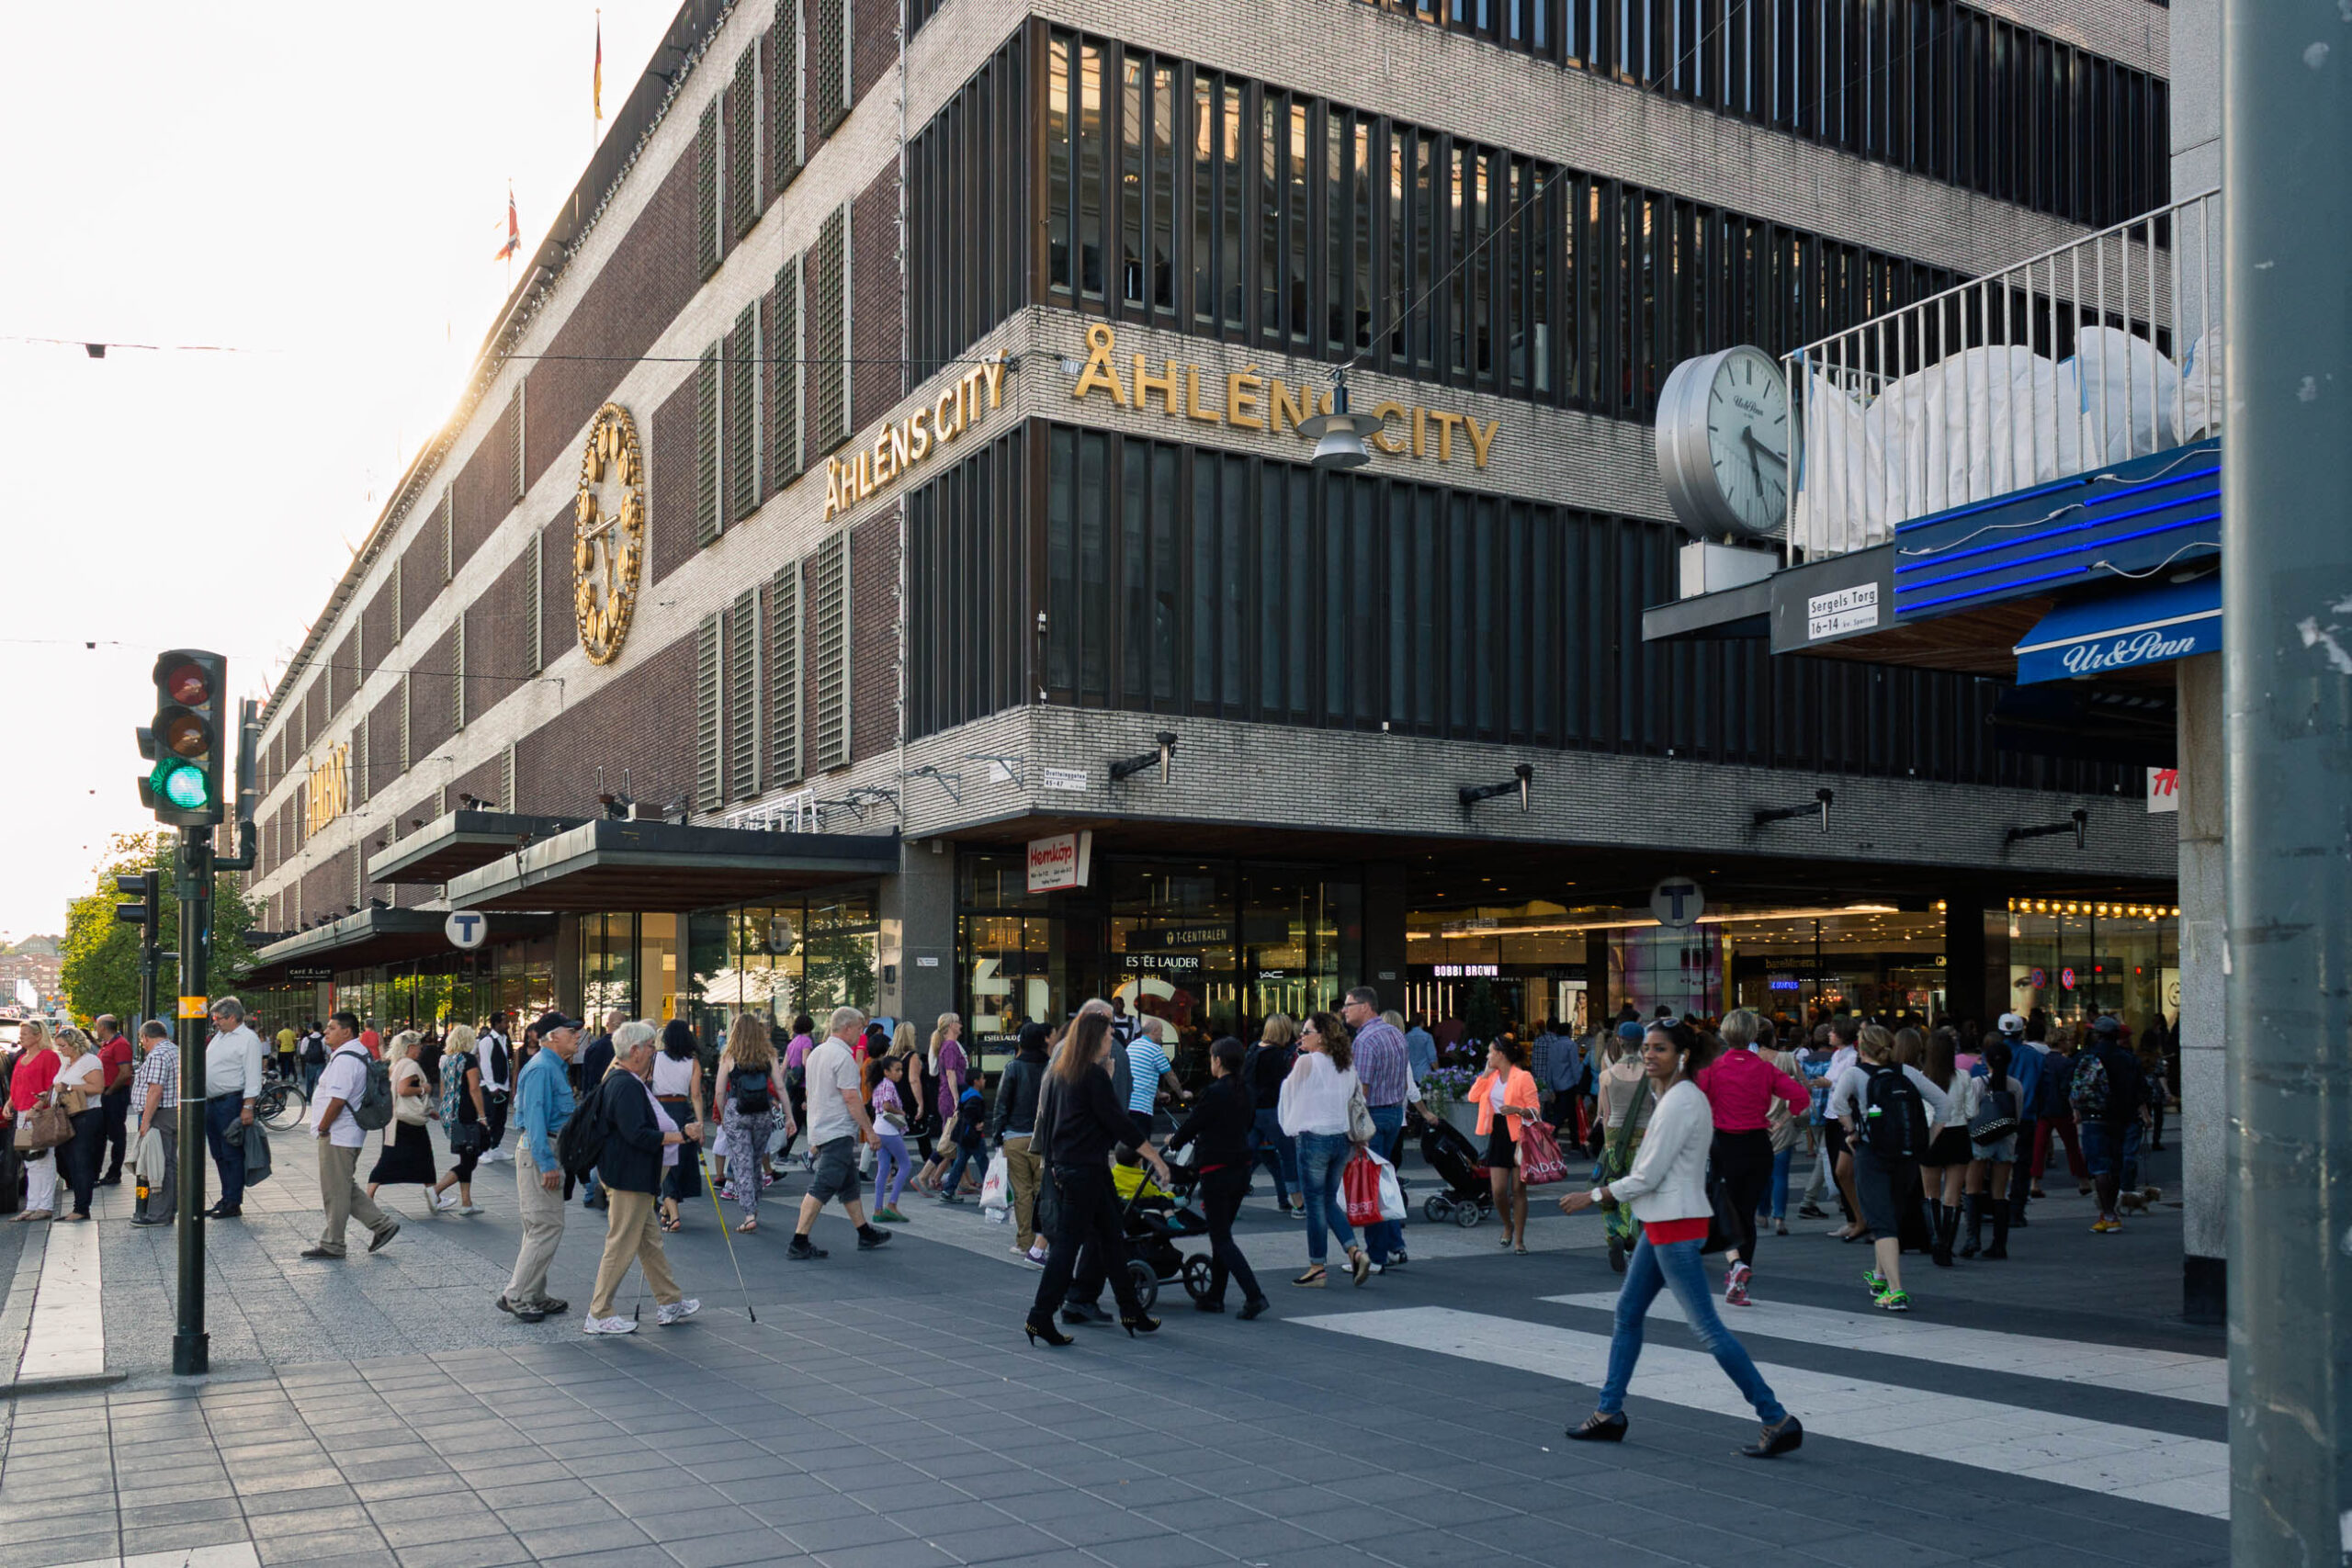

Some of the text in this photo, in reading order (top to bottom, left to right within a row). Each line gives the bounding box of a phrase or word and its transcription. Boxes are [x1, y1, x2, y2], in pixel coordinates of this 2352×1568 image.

[823, 348, 1008, 523] ÅHLÉNS CITY
[1372, 401, 1500, 468] CITY
[1812, 591, 1875, 613] Sergels Torg
[2063, 631, 2196, 673] Ur&Penn
[2153, 769, 2178, 796] H
[1031, 841, 1073, 867] Hemköp
[1659, 886, 1694, 919] T
[454, 916, 481, 942] T
[1126, 955, 1199, 968] ESÉE LAUDER
[1434, 965, 1498, 976] BOBBI BROWN
[1766, 958, 1823, 968] bareMineras
[1122, 974, 1160, 982] CHNEL
[1527, 1161, 1566, 1174] INDEX
